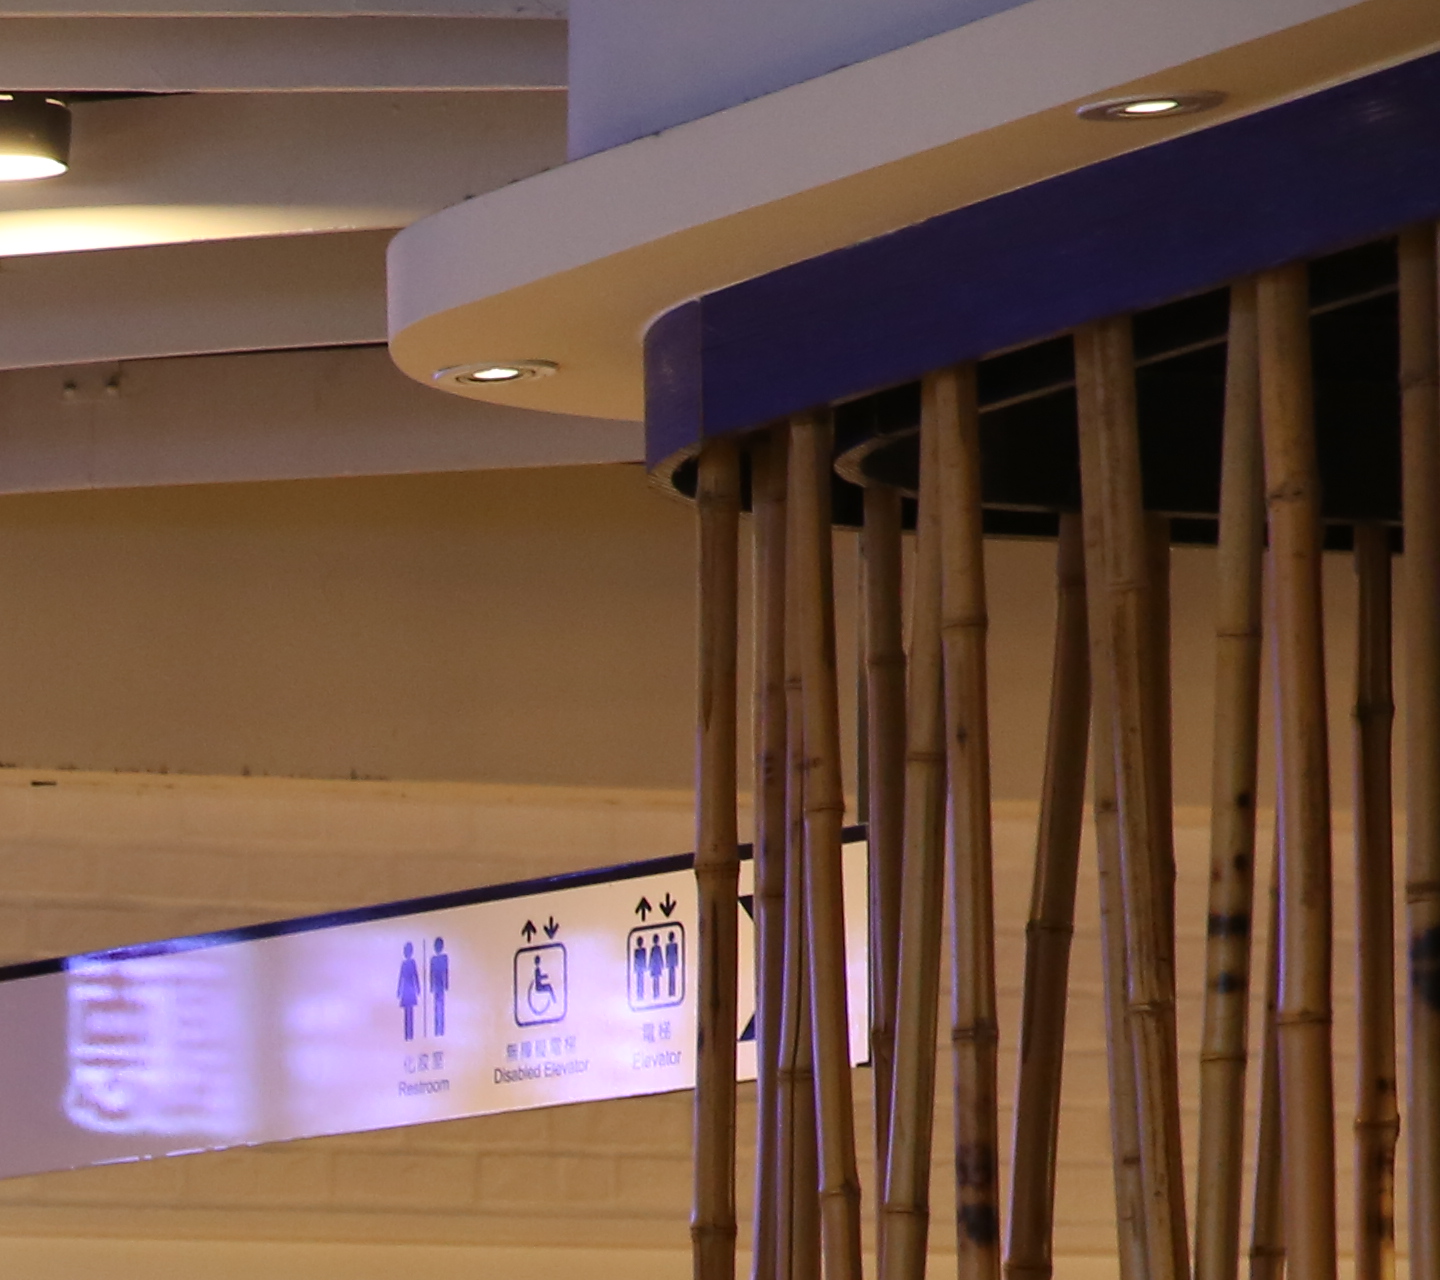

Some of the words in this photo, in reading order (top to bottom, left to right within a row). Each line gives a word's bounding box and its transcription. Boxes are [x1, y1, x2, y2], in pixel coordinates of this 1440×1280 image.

[631, 1049, 682, 1070] Elevator
[493, 1065, 541, 1085] Disabled
[543, 1056, 590, 1078] Elevator
[397, 1076, 451, 1097] Restroom
